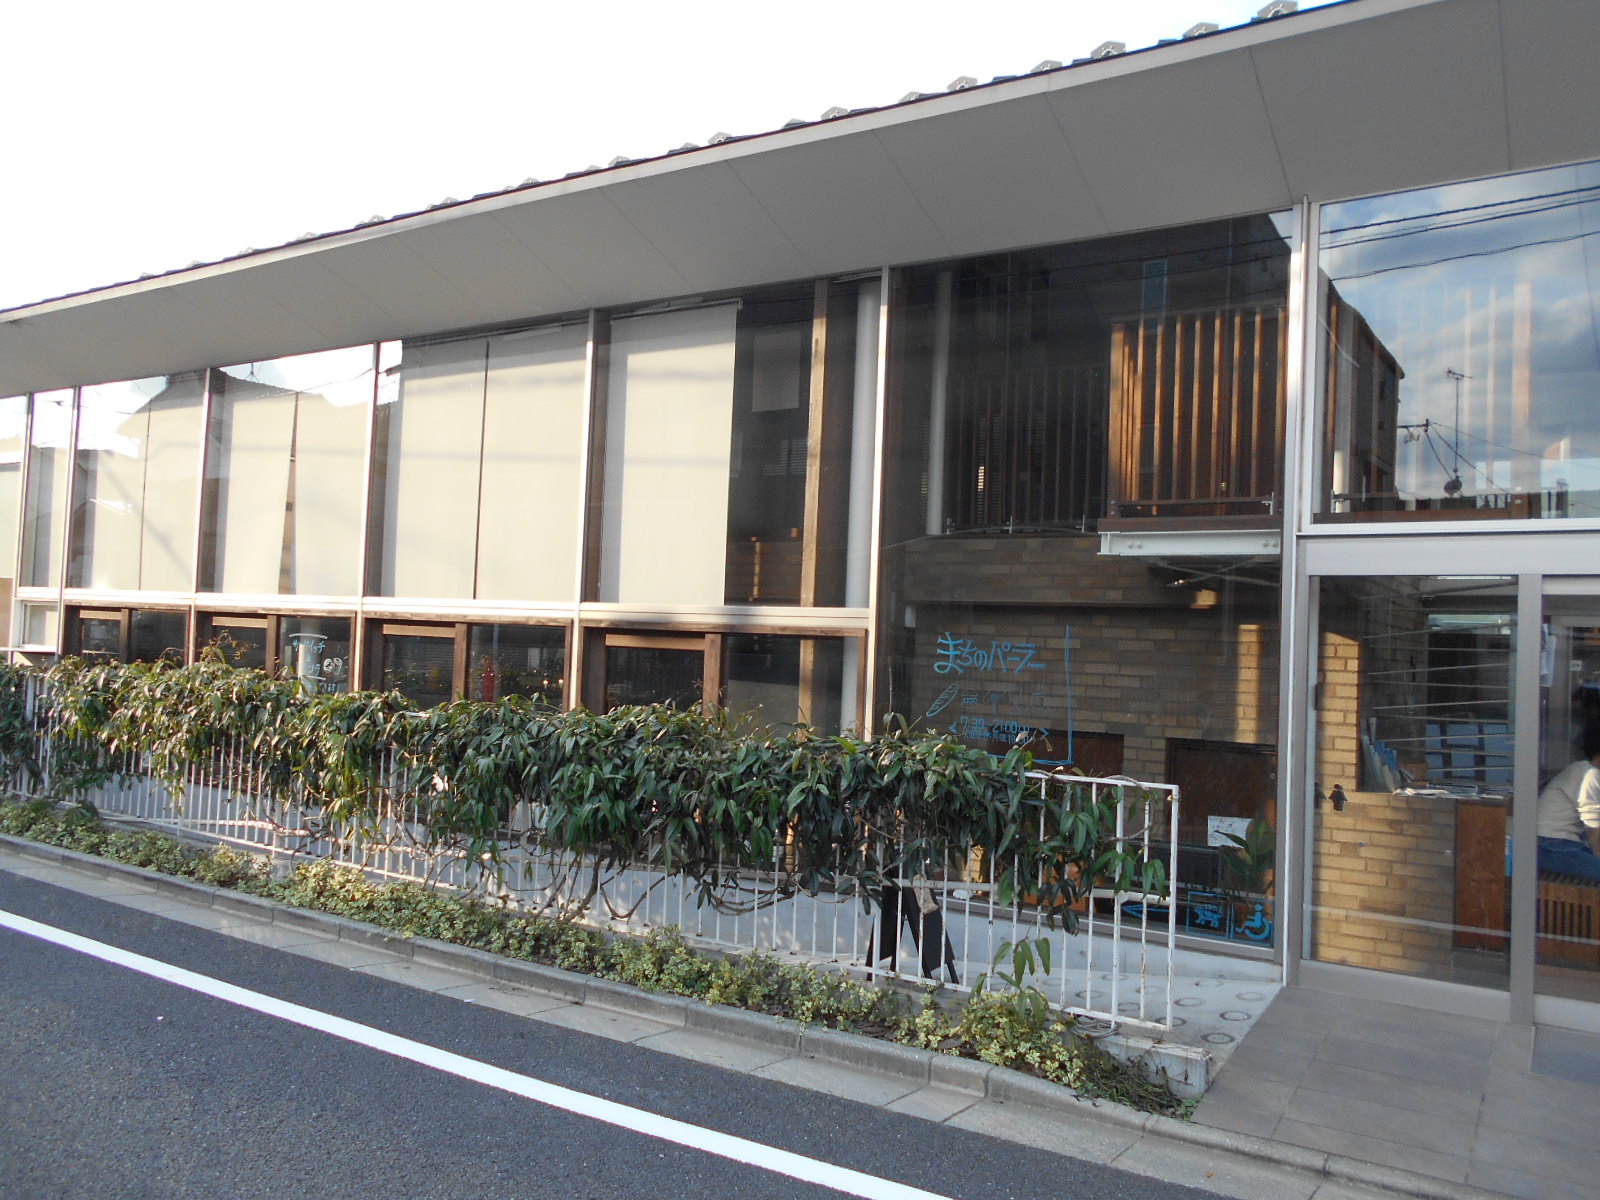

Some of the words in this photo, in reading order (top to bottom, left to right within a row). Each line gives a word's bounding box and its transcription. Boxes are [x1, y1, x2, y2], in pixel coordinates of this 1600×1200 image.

[933, 631, 1046, 674] まちのパーラー
